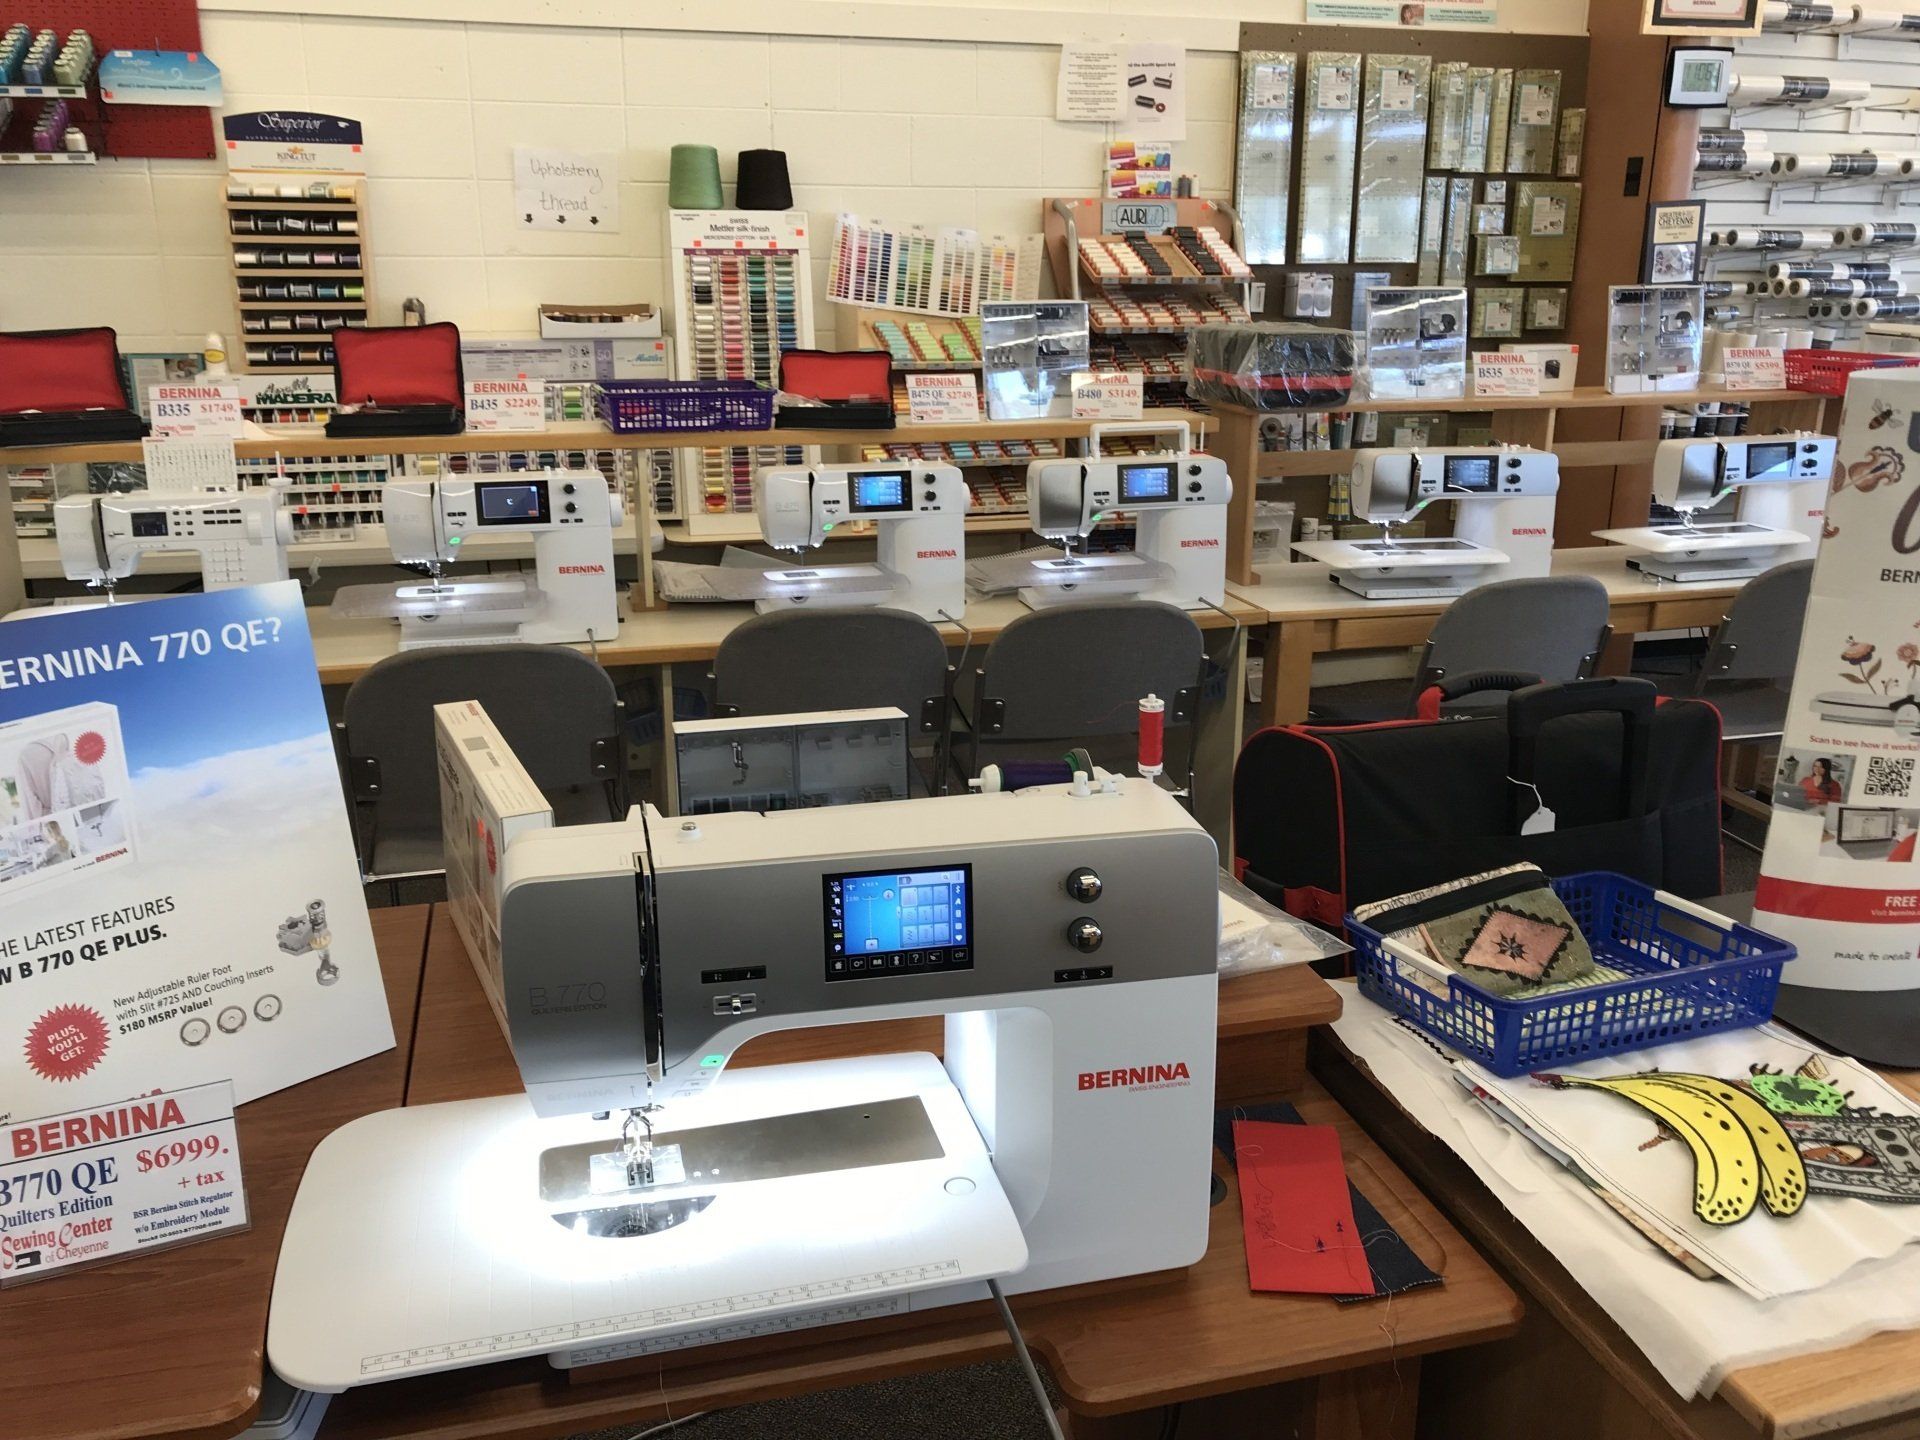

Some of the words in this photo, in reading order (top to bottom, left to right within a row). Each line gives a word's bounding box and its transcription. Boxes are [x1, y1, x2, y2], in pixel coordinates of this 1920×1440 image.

[258, 112, 324, 133] Superior
[277, 152, 298, 160] KING
[529, 158, 604, 195] Upholstery
[539, 191, 589, 211] thread
[710, 224, 735, 232] Mettler
[1480, 354, 1526, 363] BERNINA
[1730, 349, 1772, 358] BERNINA
[915, 377, 963, 387] BERNINA
[1478, 367, 1503, 378] B535
[159, 387, 222, 399] BERNINA
[473, 382, 528, 393] BERNINA
[911, 389, 931, 399] B475
[932, 390, 945, 399] QE
[946, 391, 975, 400] $2749.
[1077, 389, 1102, 399] B480
[1108, 389, 1140, 399] $3149.
[255, 392, 337, 405] MADEIRA
[470, 398, 498, 410] B435
[504, 398, 541, 408] $2249.
[157, 403, 191, 417] B335
[200, 403, 238, 414] $1749.
[1180, 539, 1219, 548] BERNINA
[917, 550, 957, 559] BERNINA
[558, 565, 606, 574] BERNINA
[0, 641, 144, 690] ERNINA
[150, 628, 212, 663] 770
[221, 617, 283, 653] QE?
[1809, 735, 1830, 744] Scan
[1861, 741, 1881, 749] how
[1885, 896, 1918, 907] FREE
[0, 939, 20, 957] HE
[24, 920, 86, 951] LATEST
[91, 896, 176, 931] FEATURES
[18, 961, 33, 979] B
[37, 950, 75, 974] 770
[80, 939, 109, 962] QE
[113, 924, 167, 952] PLUS.
[113, 995, 135, 1009] New
[137, 979, 186, 1001] Adjustable
[187, 972, 211, 985] Ruler
[212, 964, 232, 977] Foot
[115, 1008, 138, 1022] with
[140, 1002, 156, 1014] Slit
[182, 988, 202, 1001] AND
[204, 974, 245, 993] Couching
[246, 964, 274, 980] Inserts
[557, 981, 606, 1007] 770
[119, 1019, 145, 1035] $180
[148, 1009, 178, 1026] MSRP
[180, 997, 214, 1014] Value!
[47, 1024, 80, 1044] PLUS,
[47, 1032, 88, 1055] YOU'LL
[60, 1046, 86, 1062] GET:
[1078, 1062, 1190, 1091] BERNINA
[11, 1098, 186, 1158] BERNINA
[136, 1134, 229, 1174] $6999.
[71, 1157, 118, 1194] QE
[178, 1176, 190, 1188] +
[196, 1170, 225, 1187] tax
[0, 1207, 55, 1233] Quilters
[58, 1195, 113, 1217] Edition
[133, 1209, 149, 1219] BSR
[150, 1203, 178, 1215] Bernina
[179, 1198, 199, 1209] Stitch
[200, 1191, 233, 1204] Regulator
[134, 1225, 149, 1234] w/o
[150, 1213, 198, 1231] Embroidery
[200, 1206, 230, 1220] Module
[1, 1230, 56, 1270] Sewing
[58, 1216, 113, 1248] Center
[45, 1253, 55, 1263] of
[56, 1240, 110, 1260] Cheyenne
